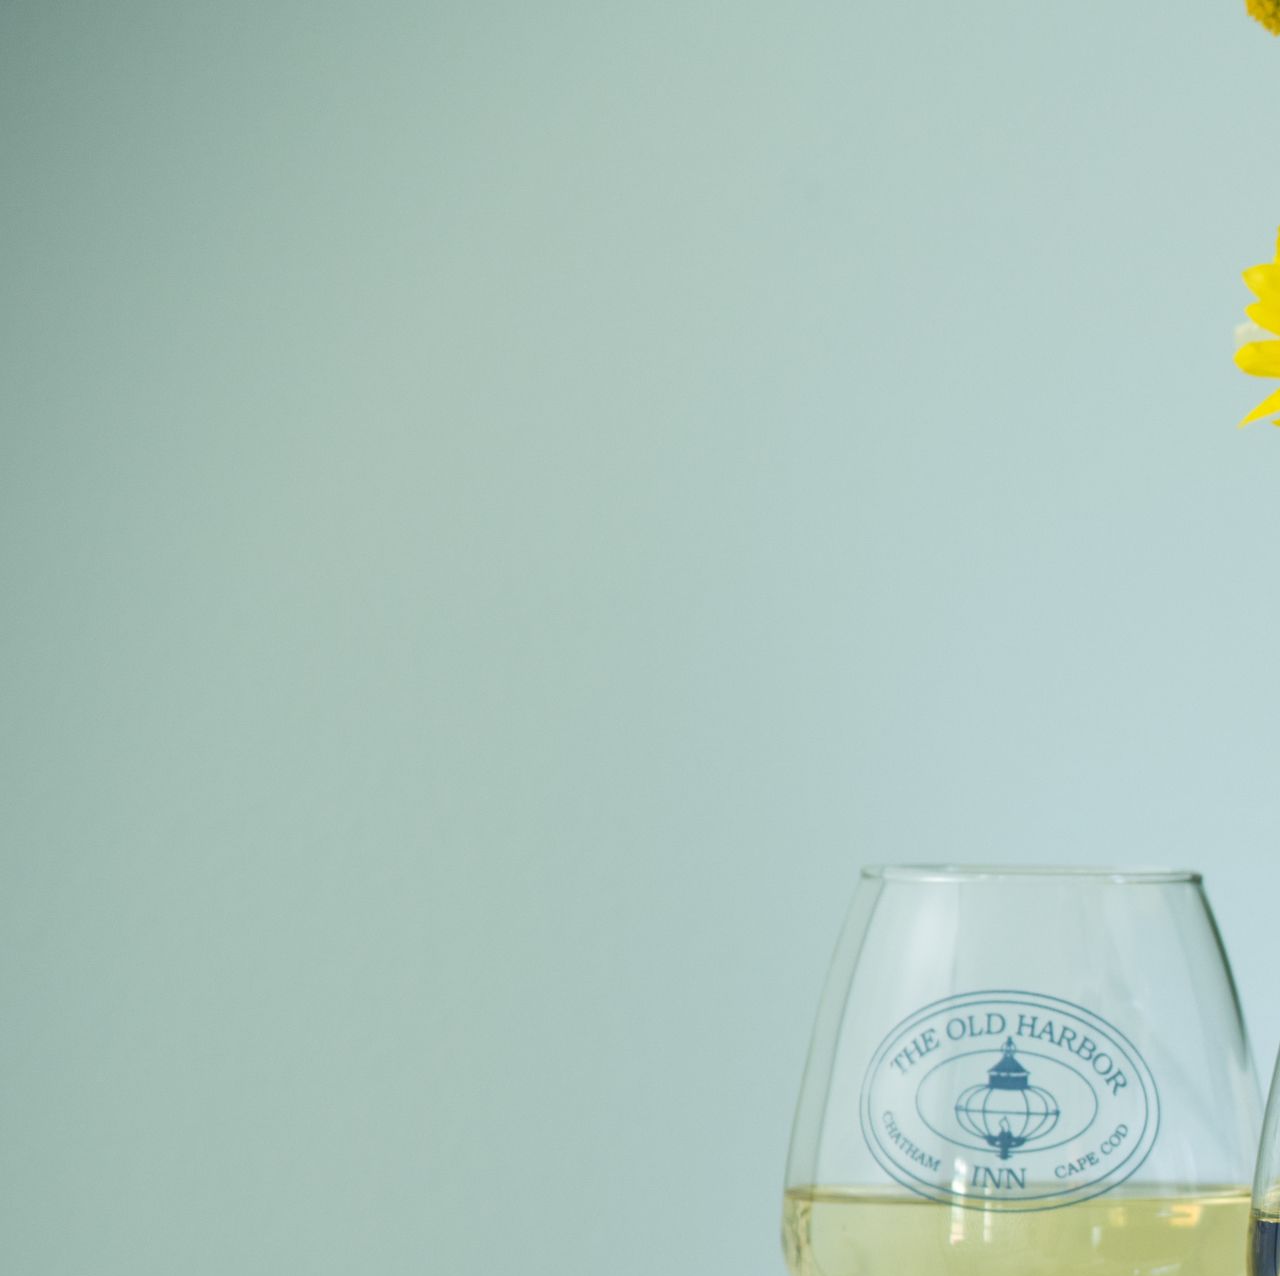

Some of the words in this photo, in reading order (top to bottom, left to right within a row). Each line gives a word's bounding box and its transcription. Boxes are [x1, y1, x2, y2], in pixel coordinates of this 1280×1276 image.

[890, 1028, 941, 1075] THE
[946, 1013, 1006, 1040] OLD
[1016, 1014, 1128, 1096] HARBOR
[882, 1110, 941, 1172] CHATHAM
[1055, 1153, 1099, 1179] CAPE
[1100, 1124, 1129, 1156] COD
[971, 1166, 1027, 1189] INN
